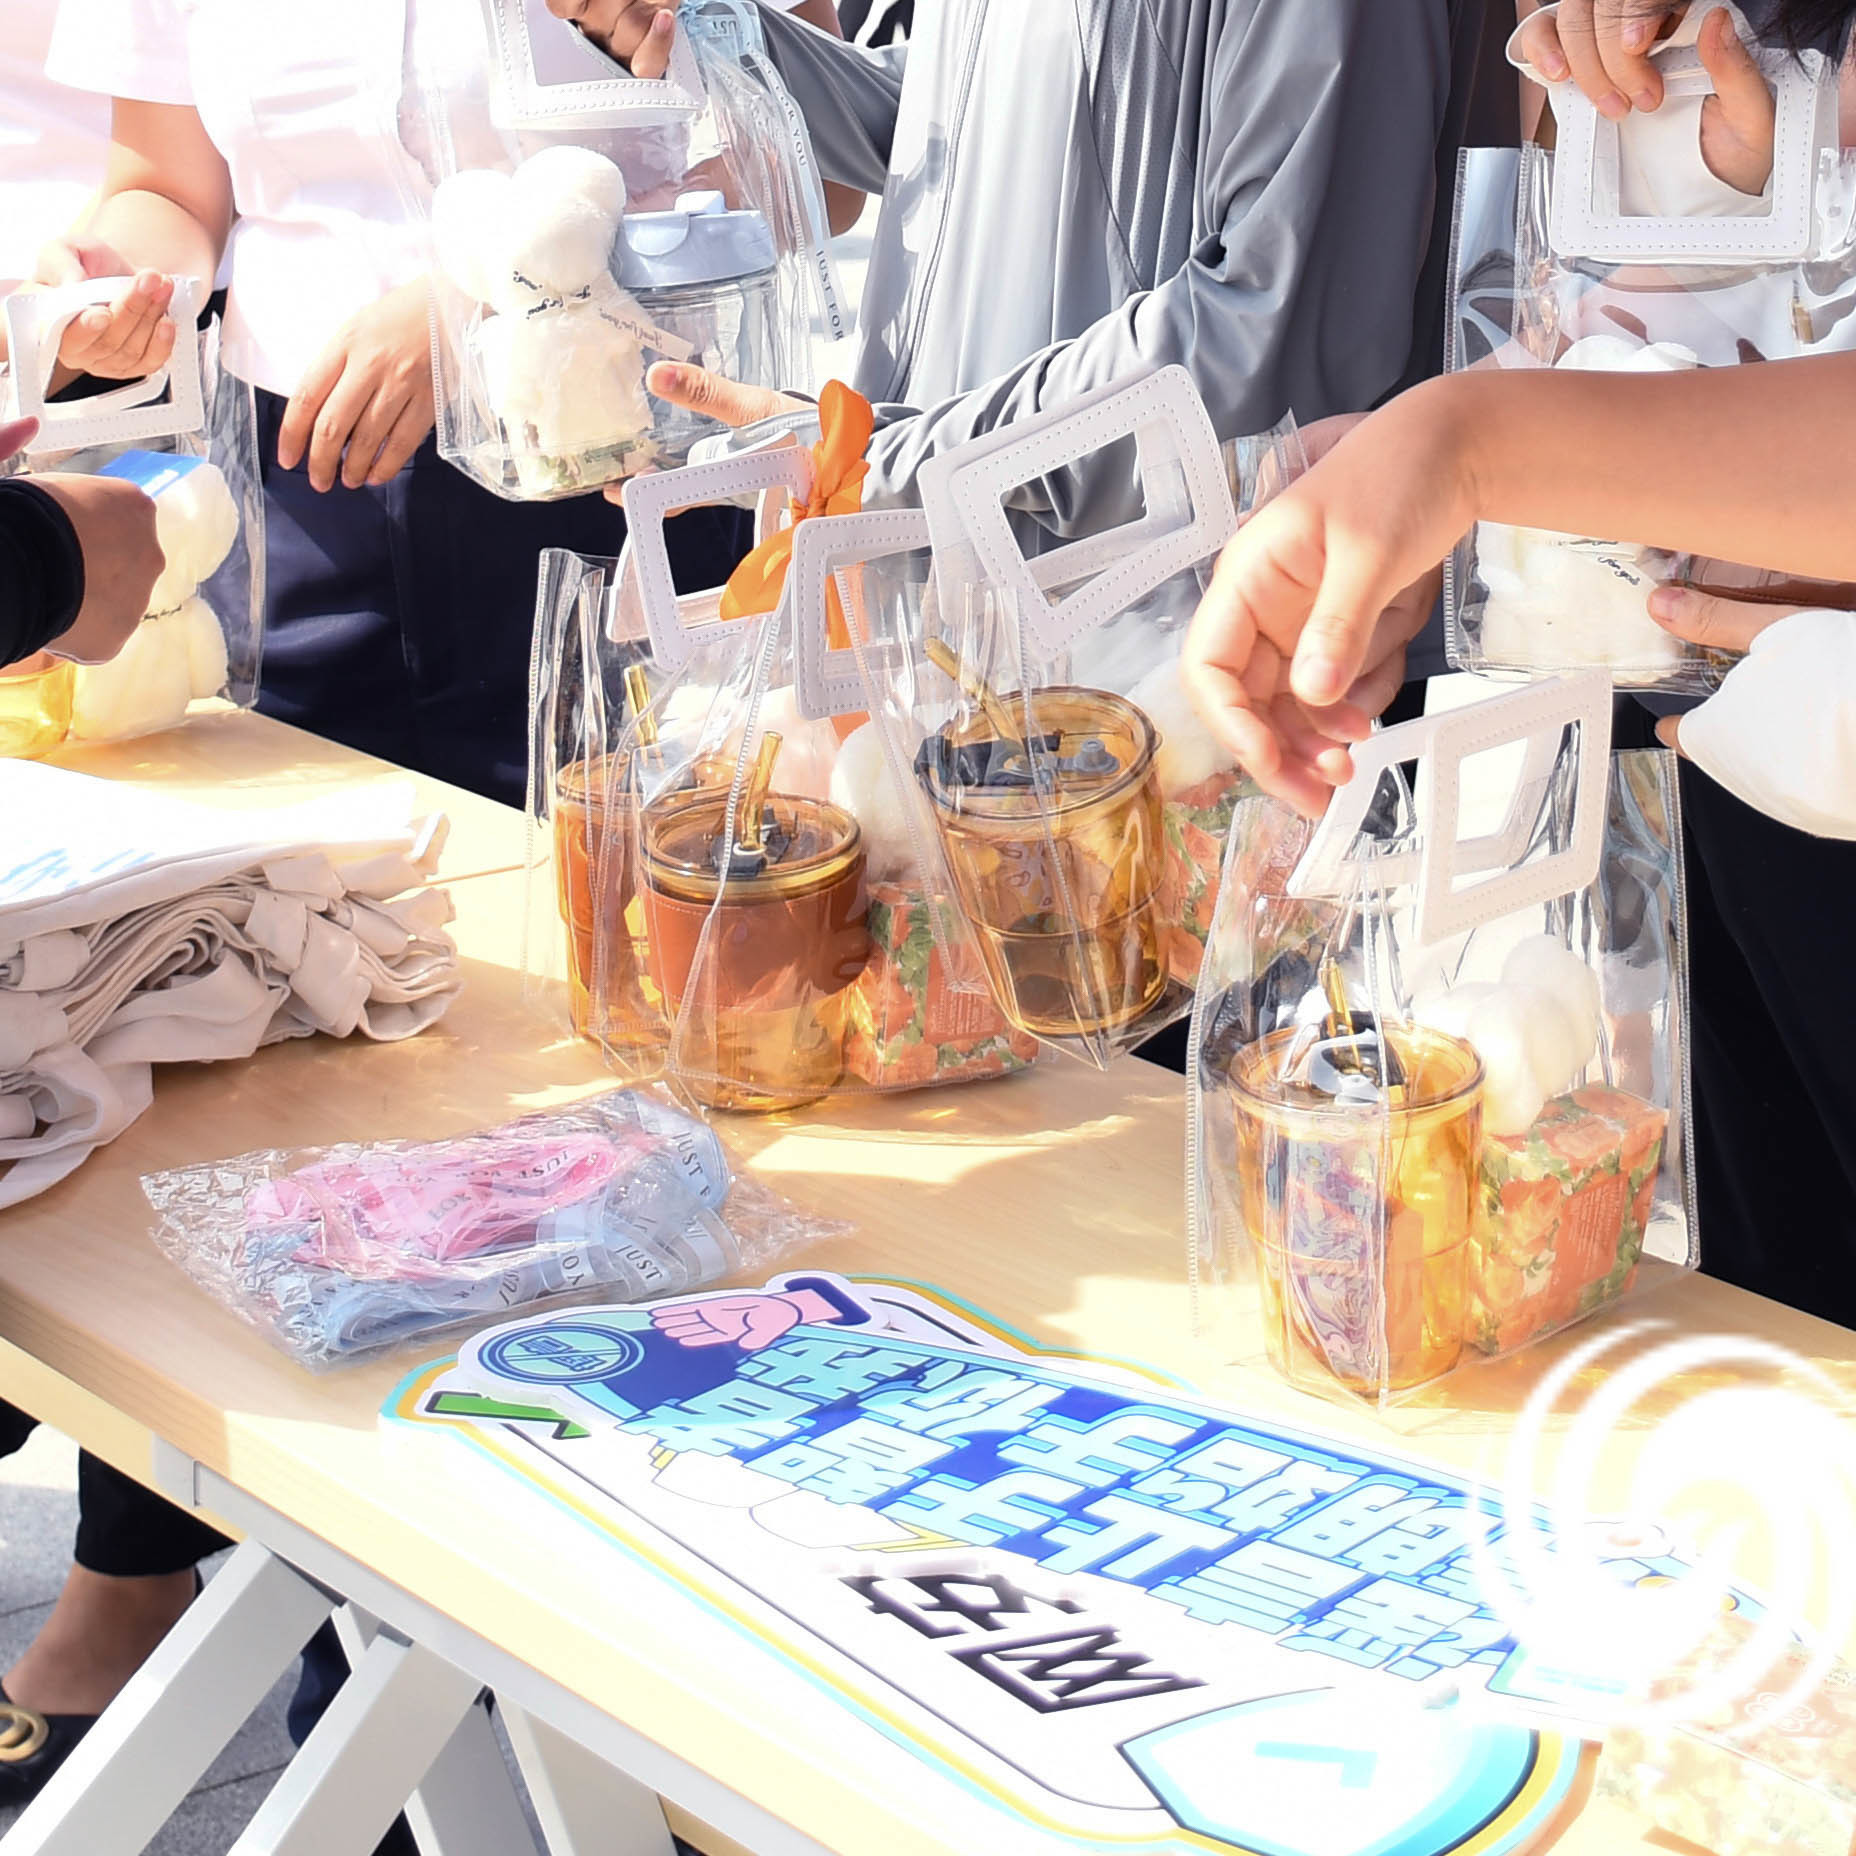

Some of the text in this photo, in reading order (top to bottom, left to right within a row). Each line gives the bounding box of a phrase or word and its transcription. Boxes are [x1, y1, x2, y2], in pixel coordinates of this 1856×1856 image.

[815, 249, 845, 341] JUST FOR
[673, 1132, 704, 1177] JUST
[616, 1244, 664, 1281] JUST
[614, 1378, 1516, 1681] 谣言止于智者
